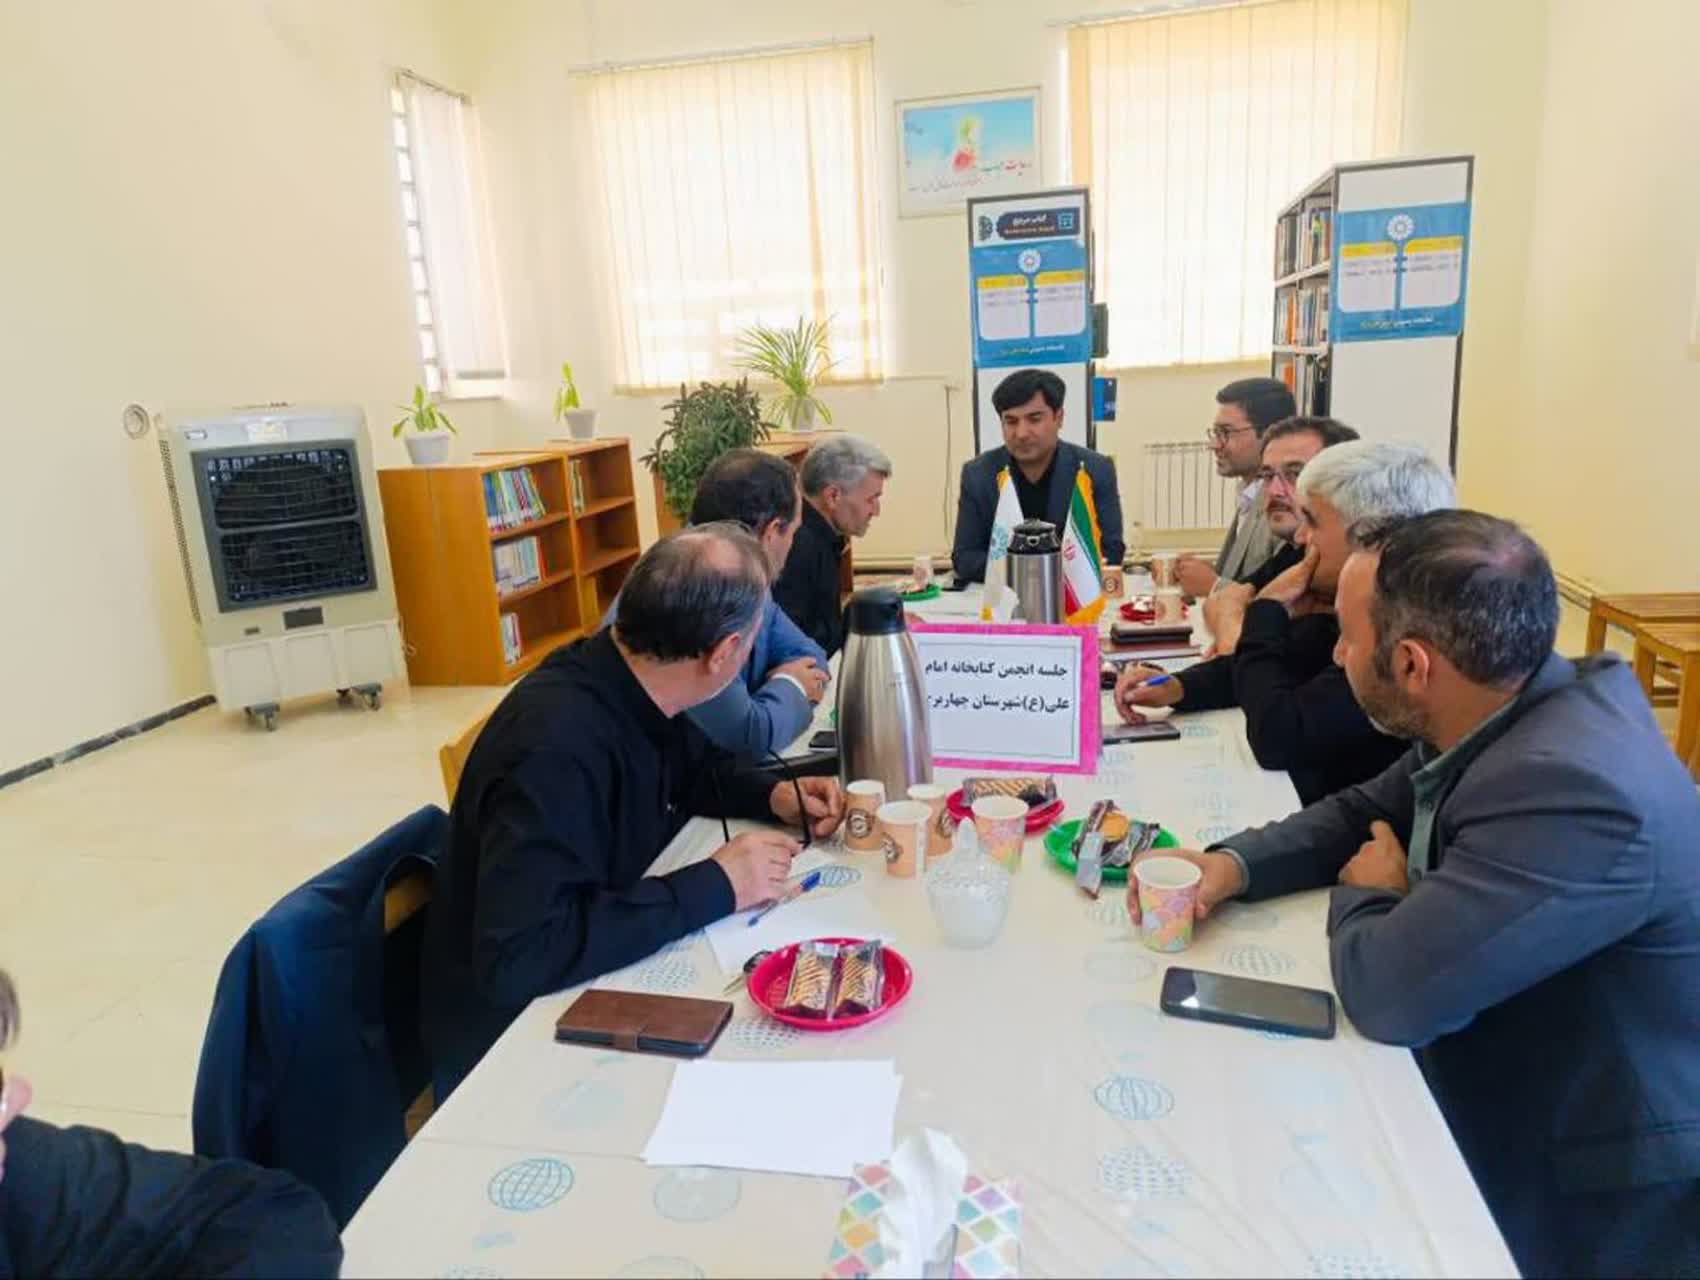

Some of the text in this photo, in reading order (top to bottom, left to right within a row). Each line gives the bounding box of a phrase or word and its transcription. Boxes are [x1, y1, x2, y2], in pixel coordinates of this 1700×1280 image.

[925, 660, 1067, 681] جلسه انجمن کتابخانه امام
